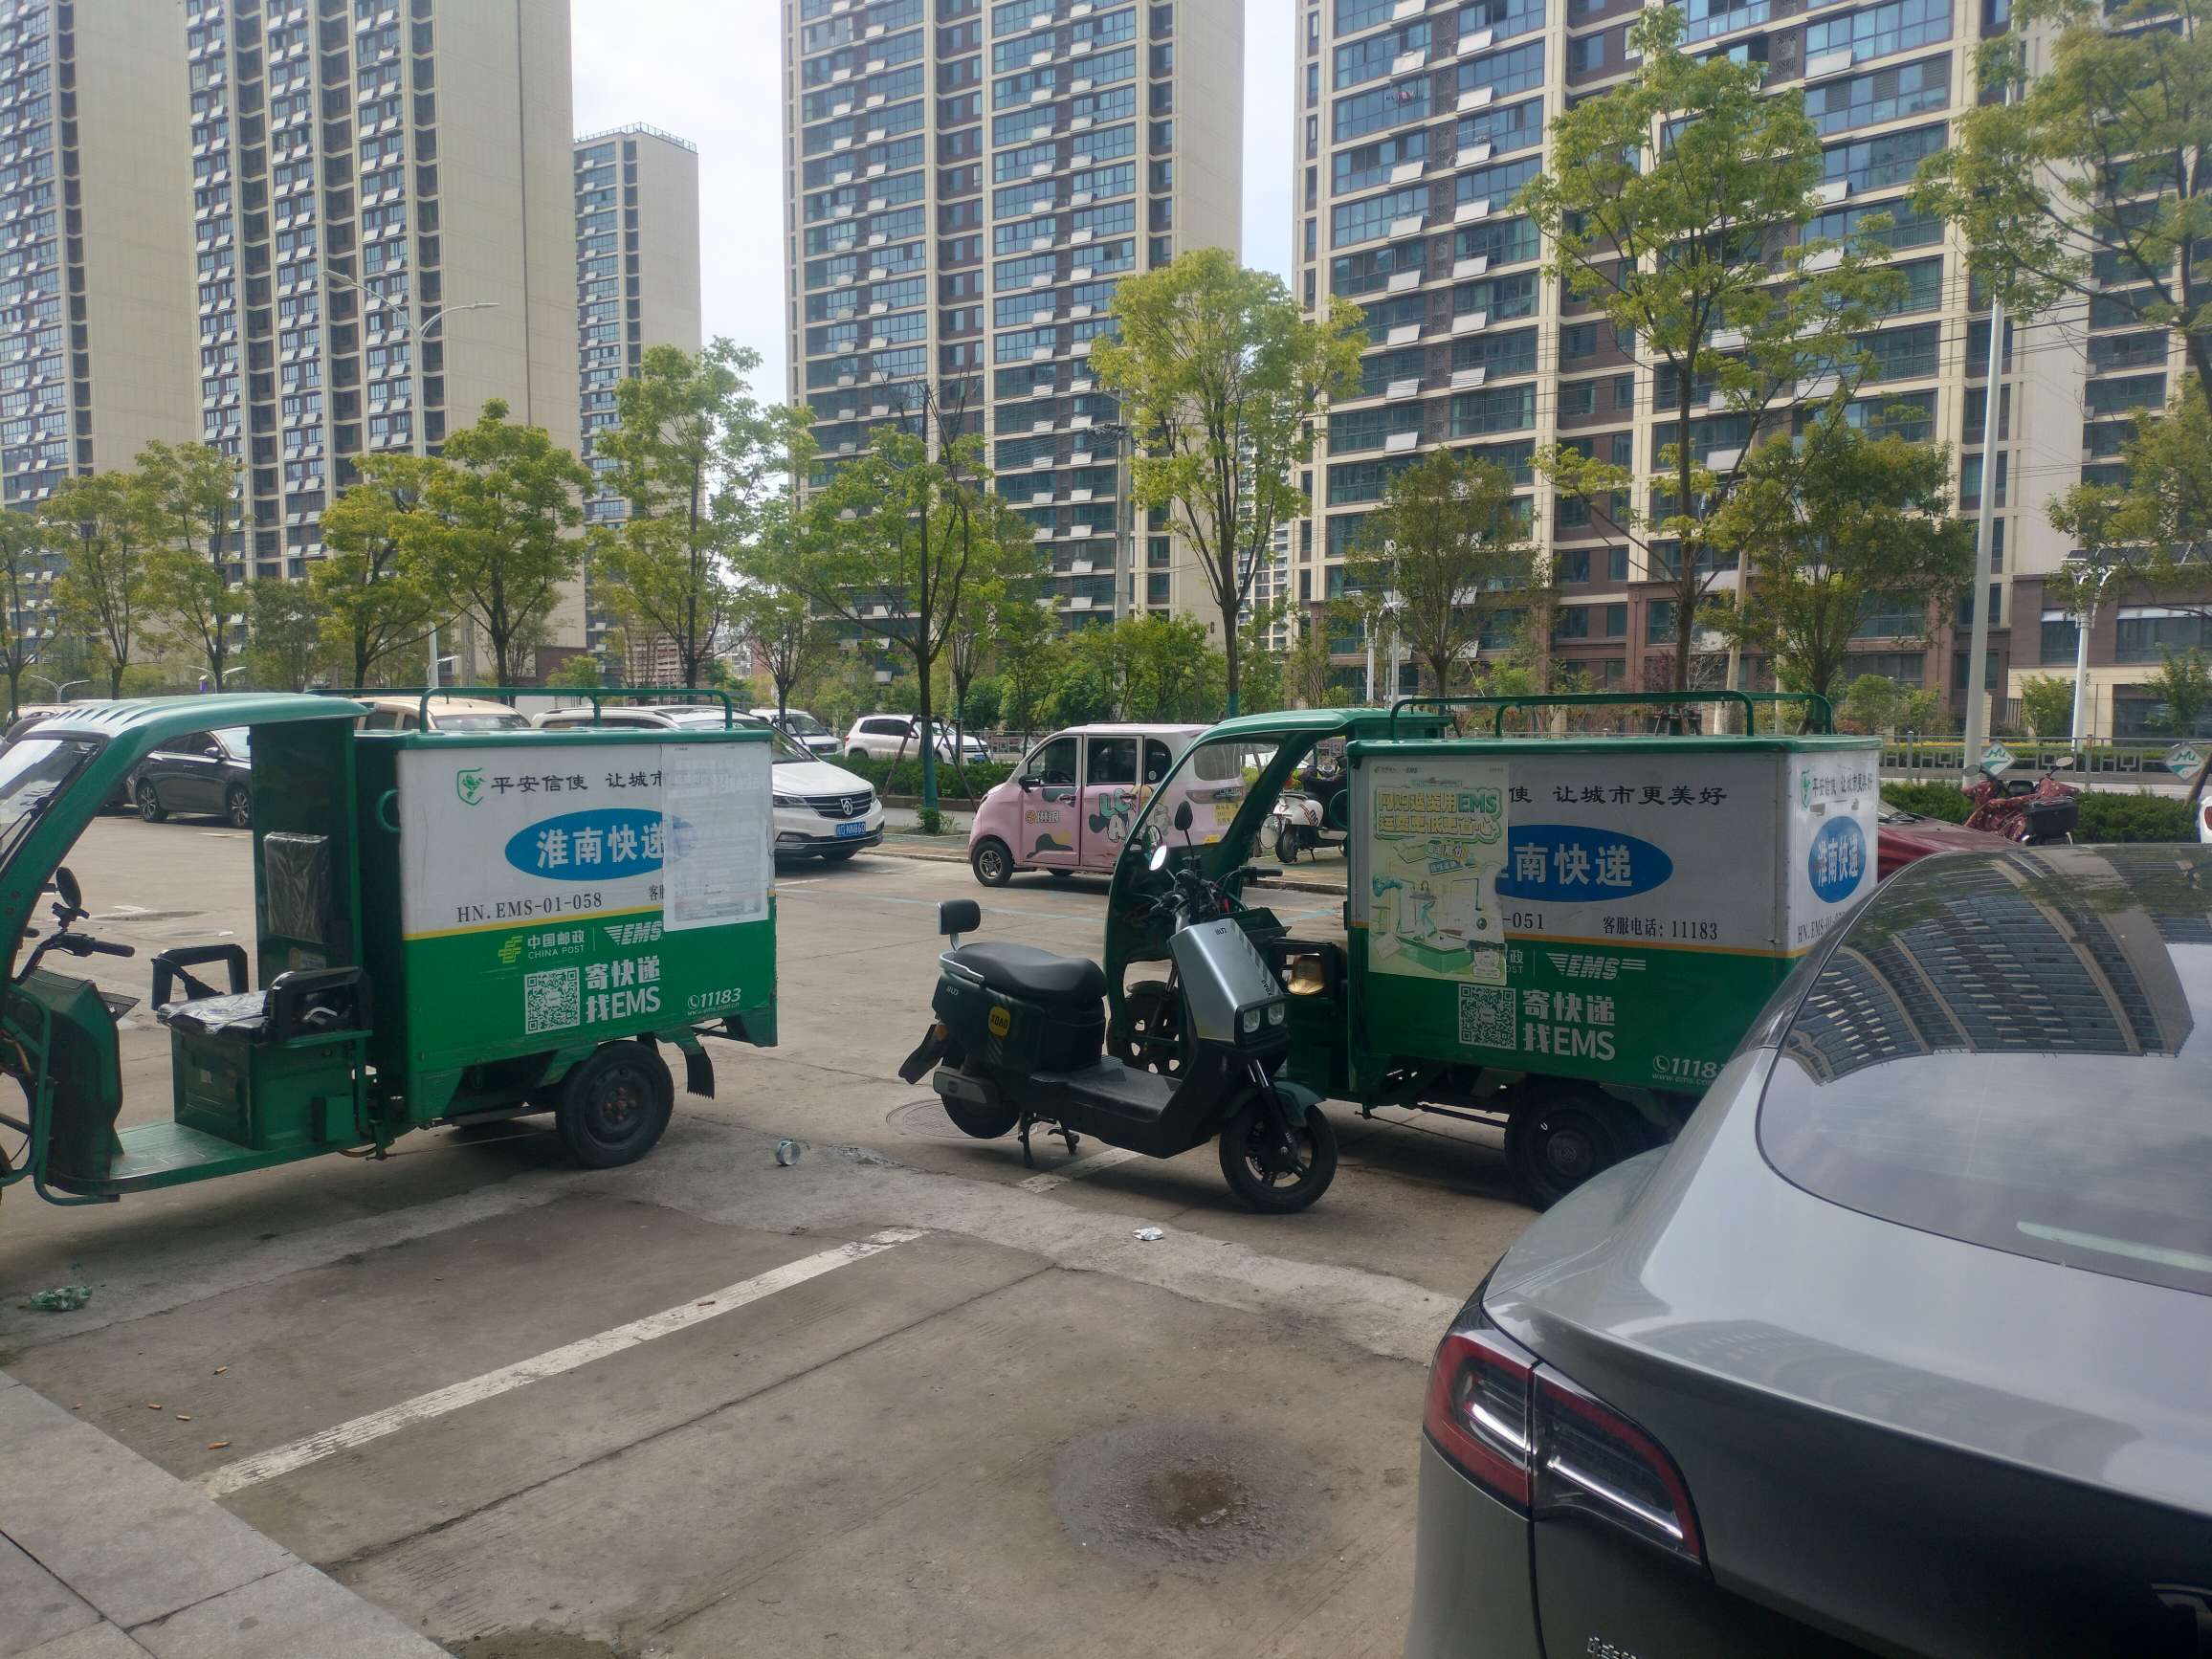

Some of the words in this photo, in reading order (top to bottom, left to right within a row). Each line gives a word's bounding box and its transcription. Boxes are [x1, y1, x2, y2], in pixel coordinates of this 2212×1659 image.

[491, 773, 588, 794] 平安信使
[1553, 785, 1728, 806] 让城市更美好
[536, 822, 664, 869] 淮南快递
[1498, 843, 1632, 887] 南快递
[1818, 834, 1859, 888] 淮南快递
[457, 893, 603, 922] HN.EMS-01-058
[527, 930, 585, 949] 中国邮政
[620, 920, 663, 945] EMS
[528, 949, 558, 960] CHINA
[563, 944, 585, 955] POST
[585, 954, 661, 990] 寄快递
[585, 986, 661, 1024] 找EMS
[701, 987, 741, 1008] 11183
[1523, 989, 1615, 1026] 寄快递
[1523, 1023, 1616, 1061] 找EMS
[1672, 1058, 1725, 1079] 1118
